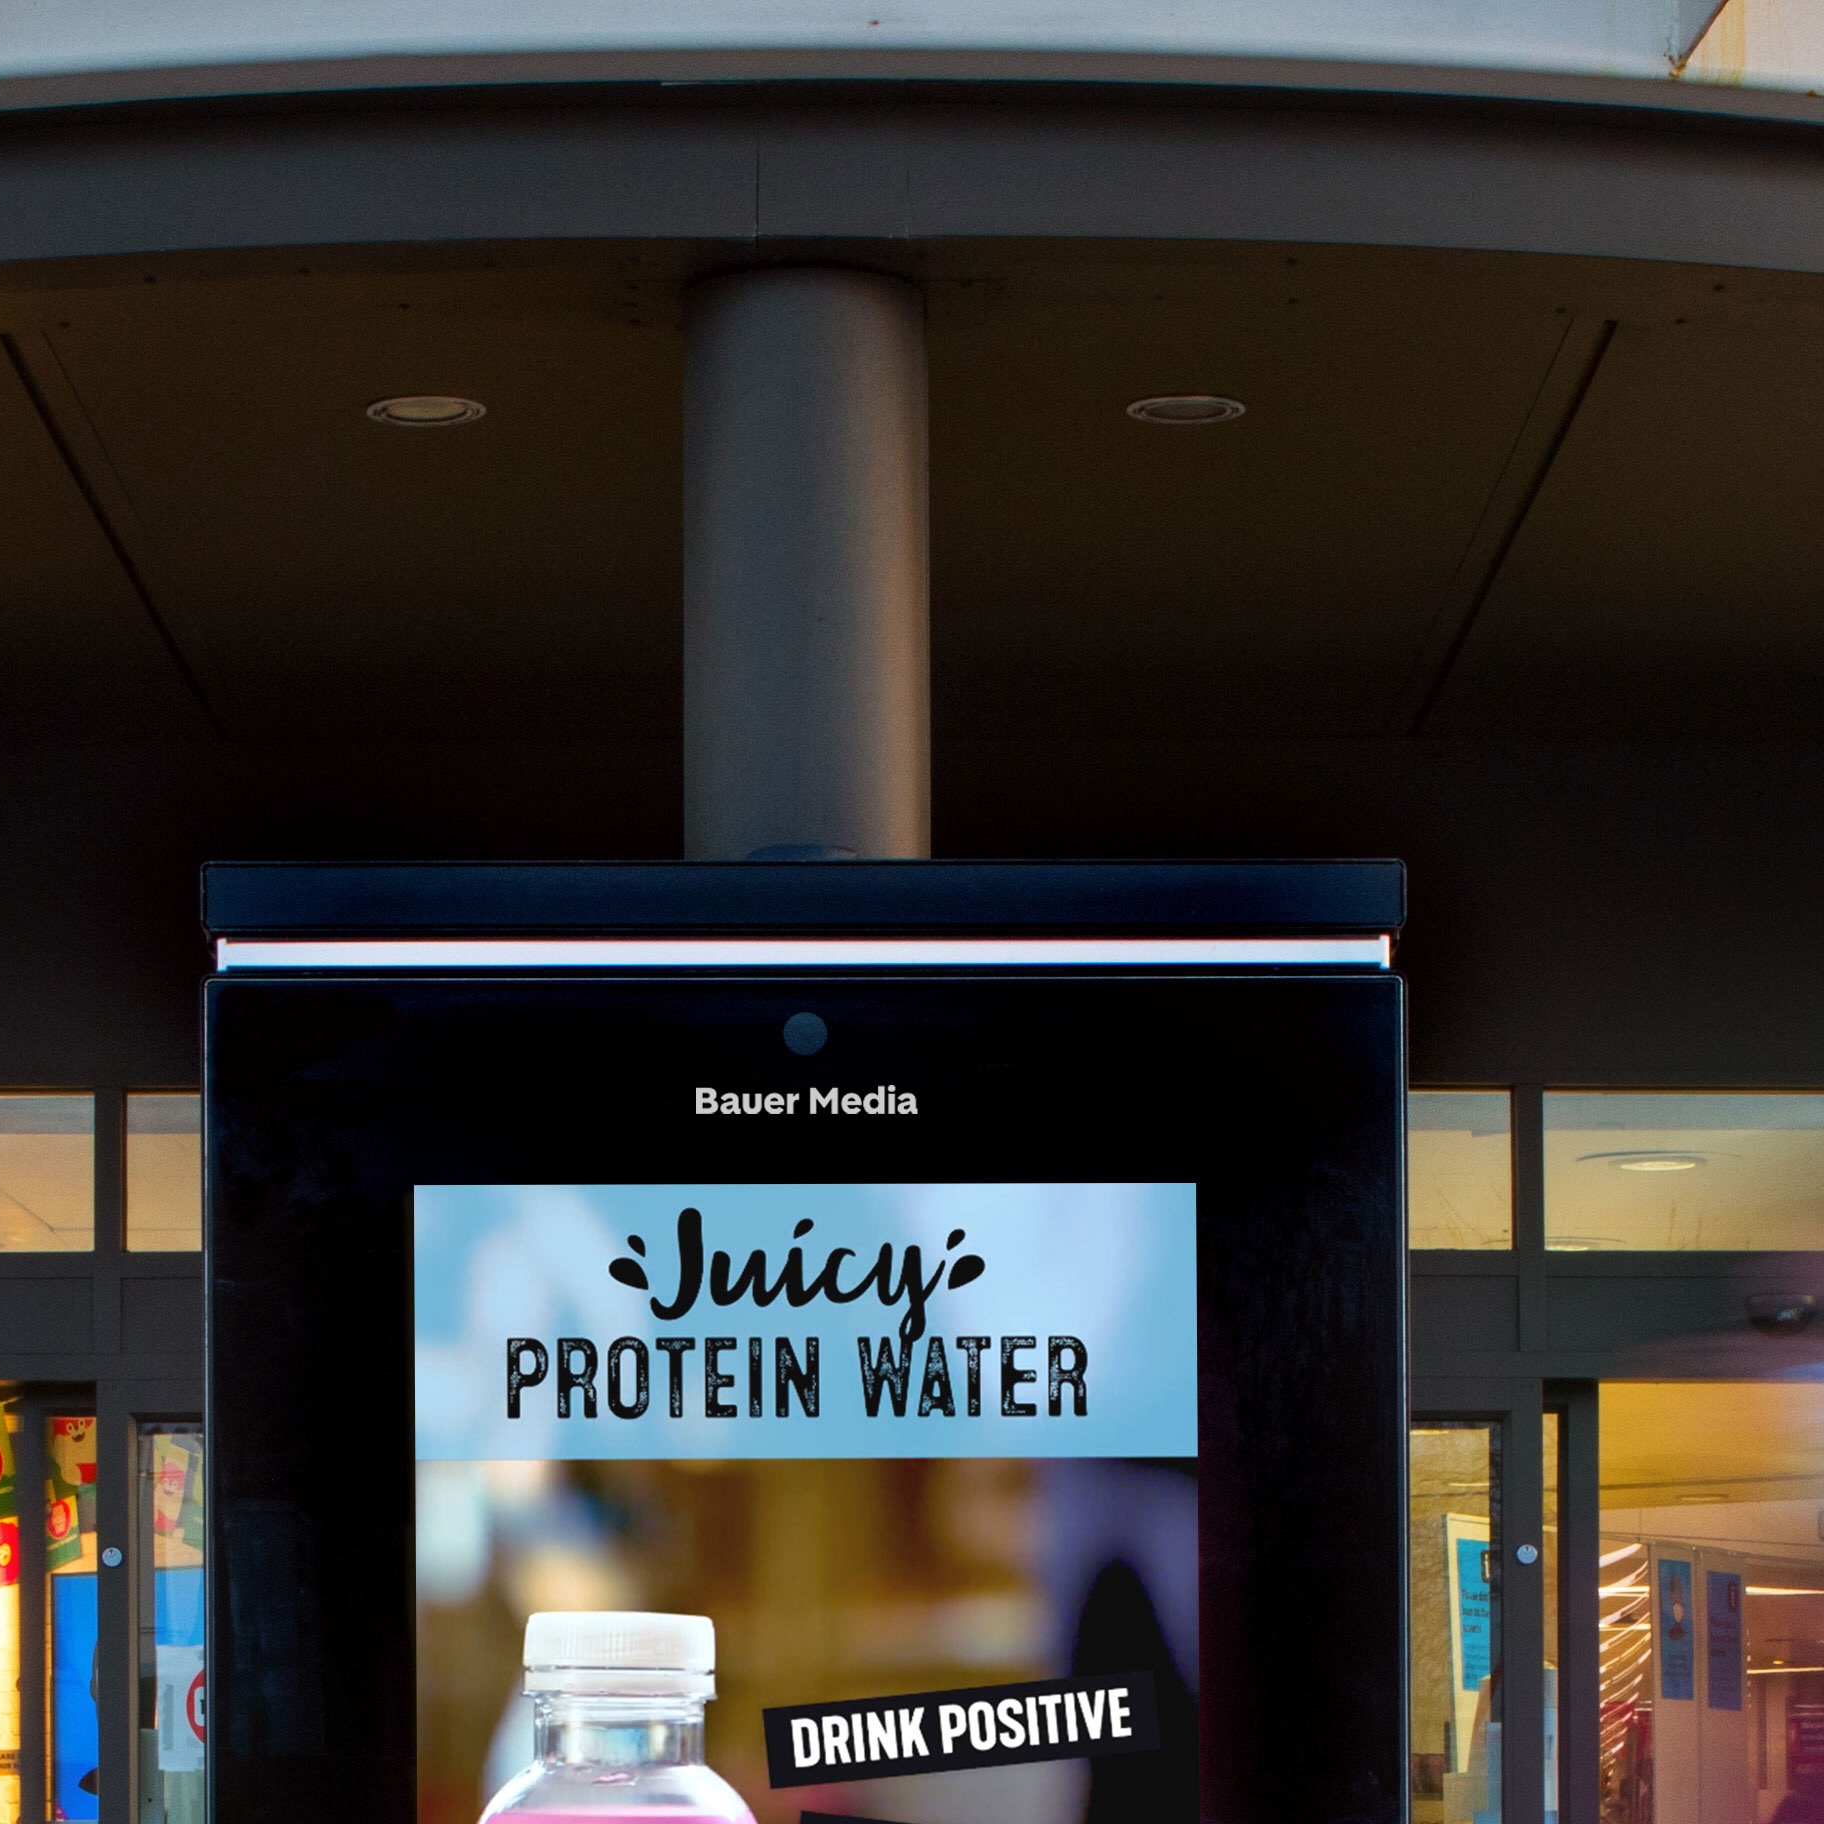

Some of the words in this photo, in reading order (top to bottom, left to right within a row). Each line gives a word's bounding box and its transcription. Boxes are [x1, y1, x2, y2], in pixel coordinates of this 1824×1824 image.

[695, 1085, 800, 1116] Bauer
[808, 1084, 919, 1116] Media
[649, 1206, 948, 1343] Juicy
[505, 1335, 822, 1421] PROTEIN
[856, 1334, 1090, 1419] WATER
[789, 1705, 931, 1768] DRINK
[938, 1687, 1133, 1754] POSITIVE
